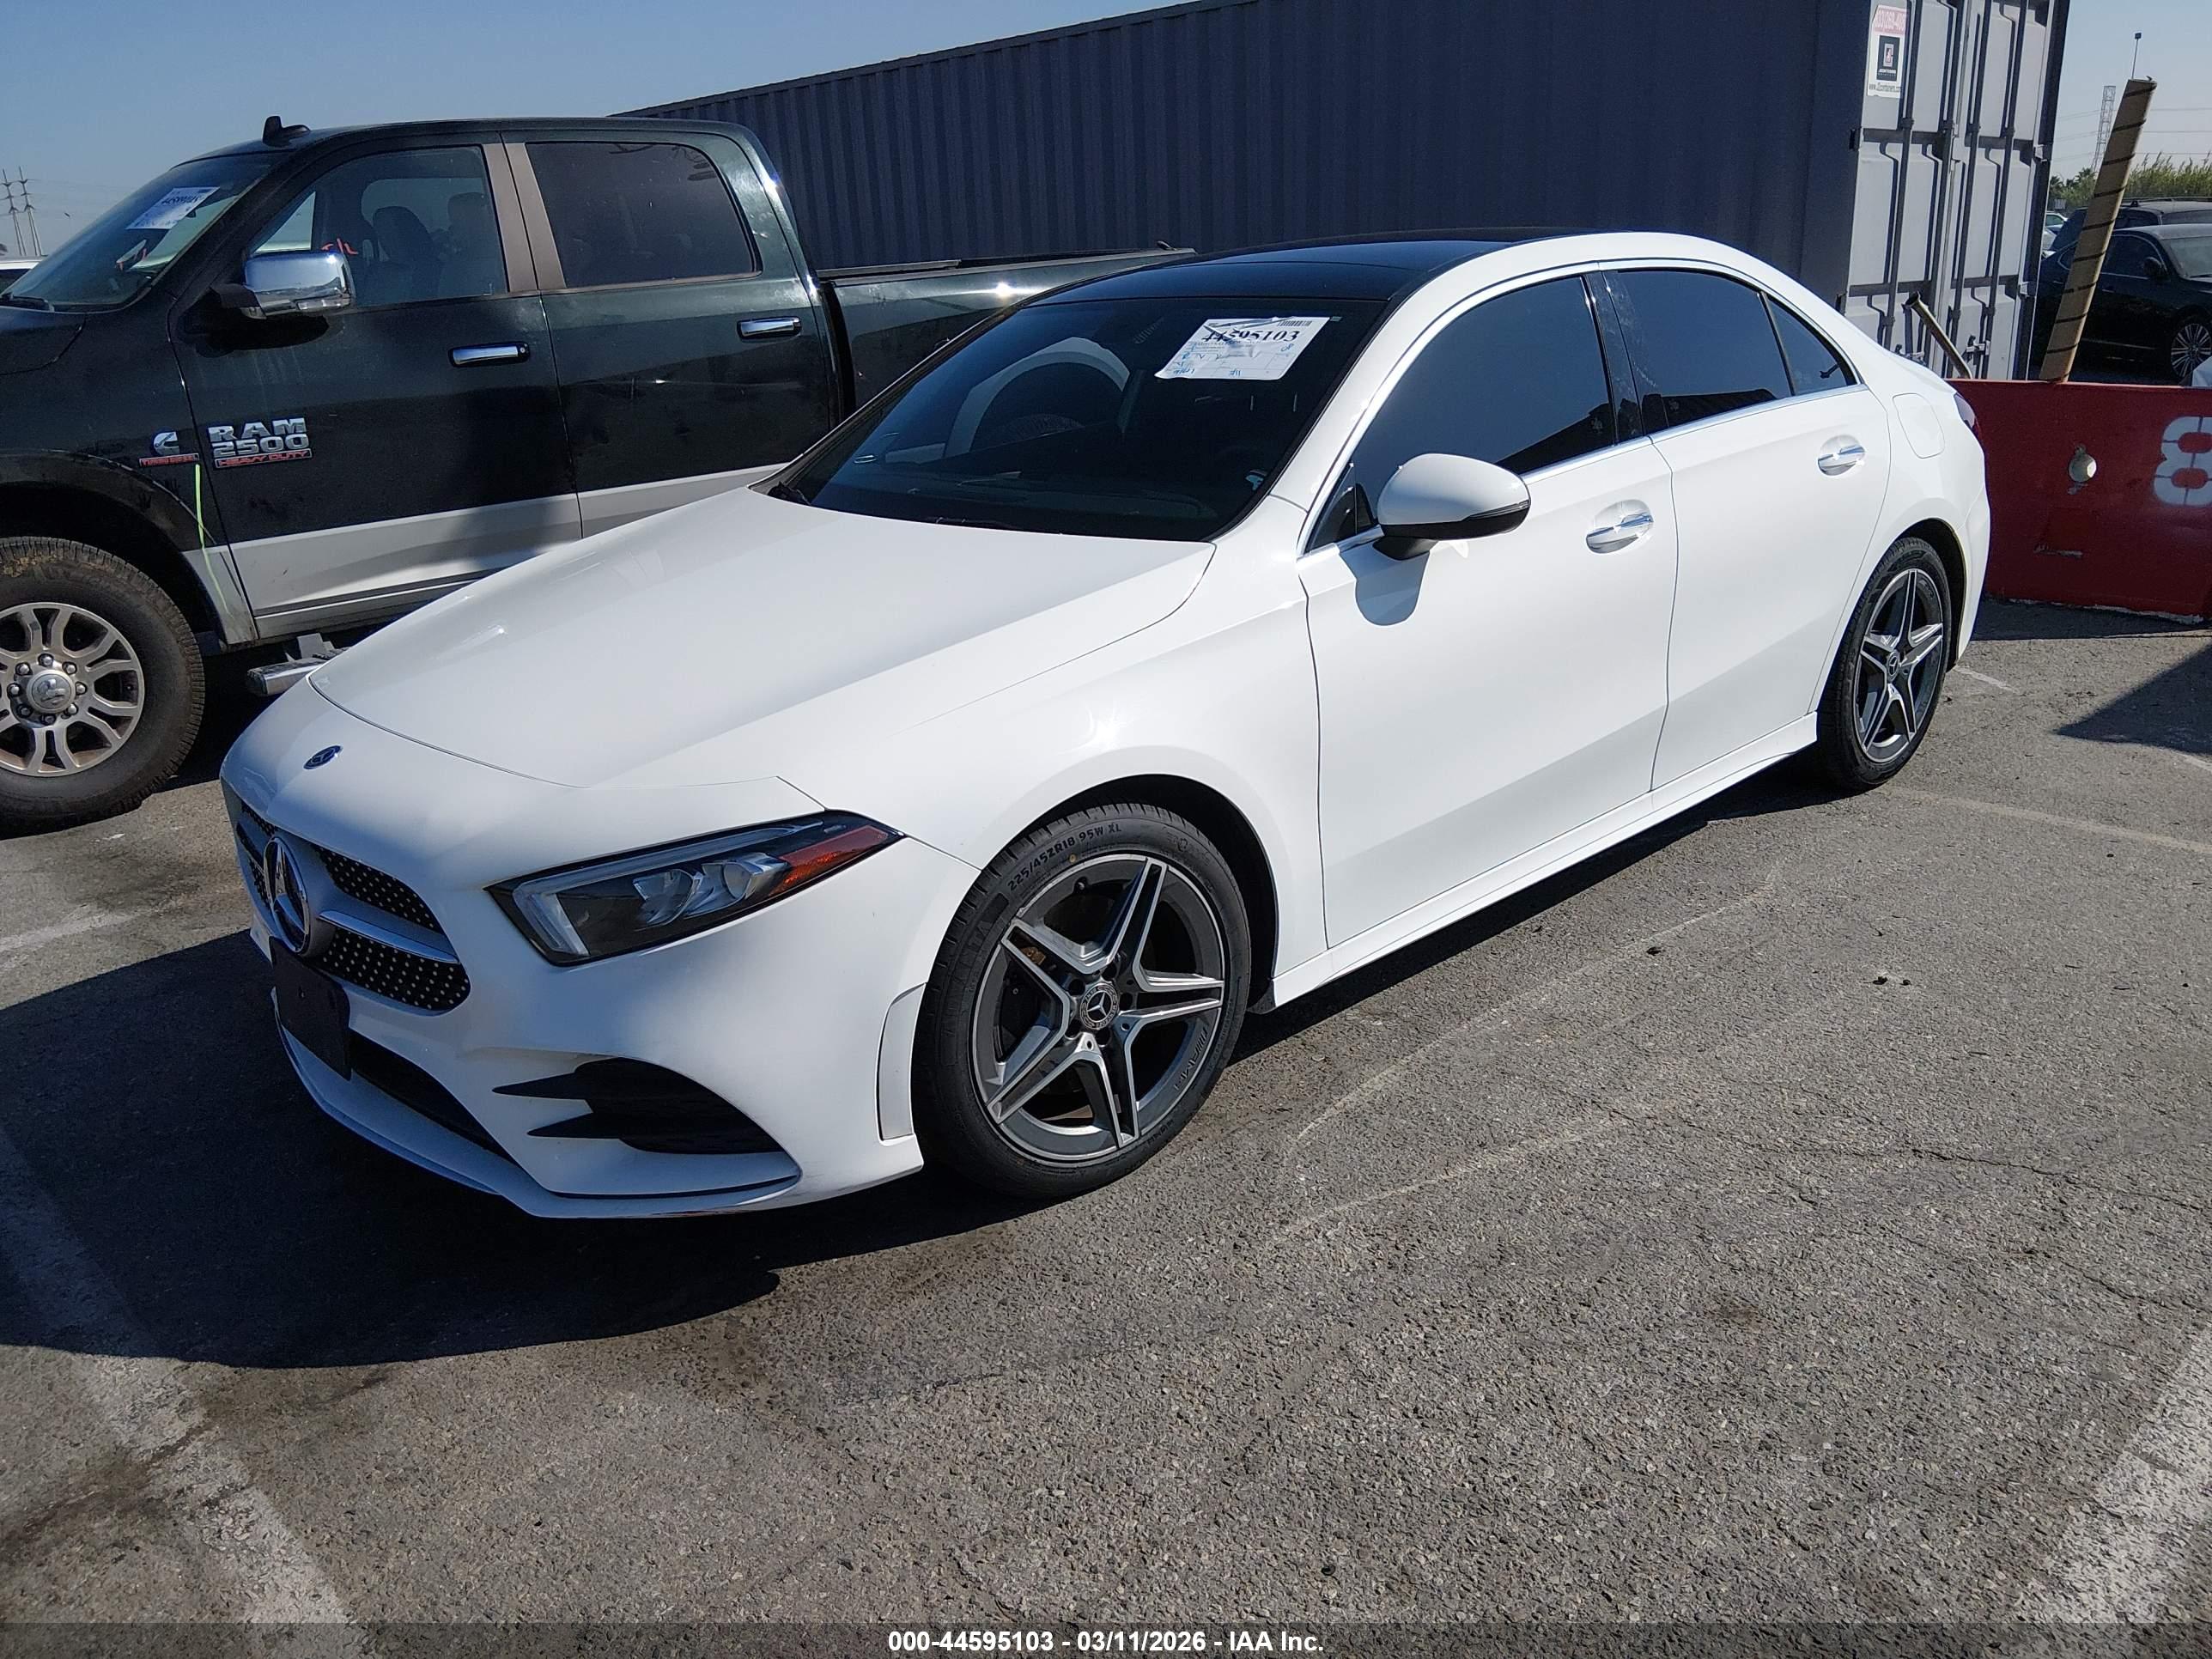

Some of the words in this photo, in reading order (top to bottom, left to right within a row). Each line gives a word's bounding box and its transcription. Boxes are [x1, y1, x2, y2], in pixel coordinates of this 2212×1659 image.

[208, 417, 307, 442] RAM
[212, 434, 310, 459] 2500
[218, 453, 266, 467] HEAVY
[268, 449, 308, 462] DUTY
[2154, 416, 2212, 506] 8
[1007, 836, 1075, 891] 225/45ZR18
[1079, 826, 1103, 841] 95W
[1108, 823, 1122, 833] XL
